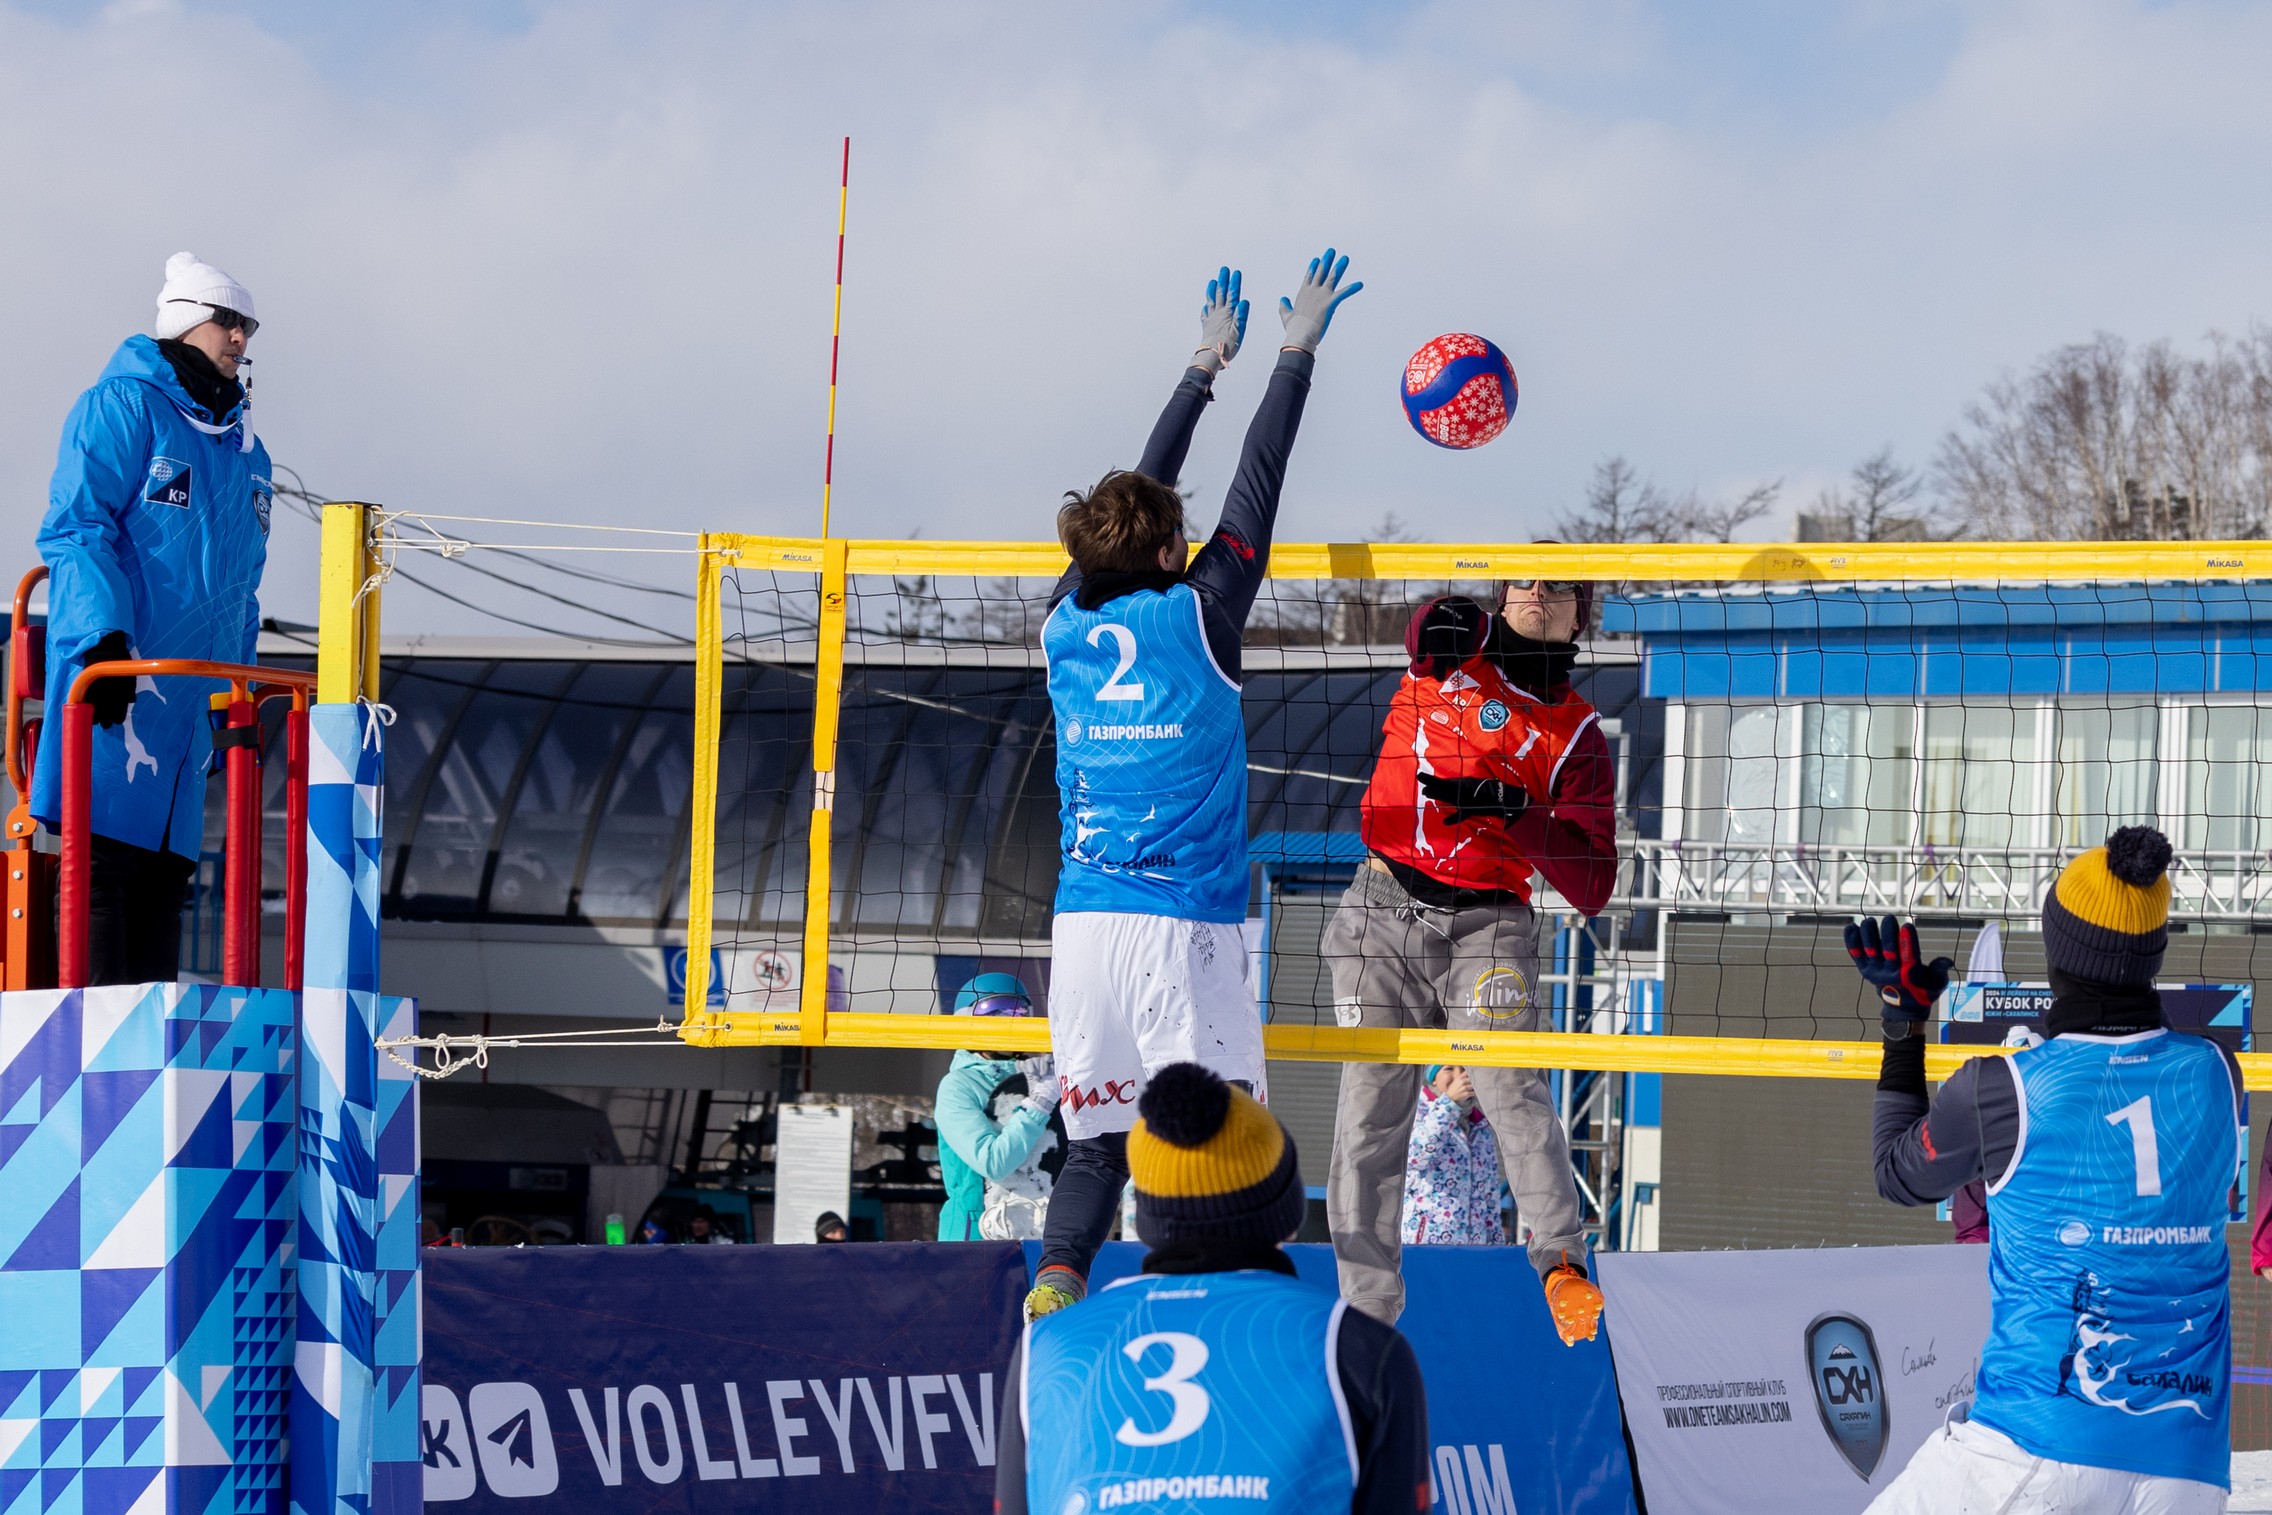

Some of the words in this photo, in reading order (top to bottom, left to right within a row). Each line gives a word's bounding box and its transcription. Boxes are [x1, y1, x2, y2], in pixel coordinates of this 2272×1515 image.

[1086, 623, 1145, 701] 2
[1088, 723, 1184, 740] ГАЗПРОМБАНК
[1985, 997, 2031, 1010] КУБОК
[2104, 1094, 2162, 1197] 1
[2103, 1225, 2212, 1245] ГАЗПРОМБАНК
[1115, 1331, 1210, 1447] 3
[1657, 1380, 1724, 1401] ПРОФЕССИОНАЛЬНЫЙ
[1725, 1378, 1767, 1398] СПОРТИВНЫЙ
[1768, 1380, 1787, 1395] КЛУБ
[567, 1372, 996, 1486] VOLLEYVFV
[1663, 1401, 1792, 1428] WWW.ONETEAMSAKHALIN.COM
[1098, 1474, 1270, 1510] ГАЗПРОМБАНК
